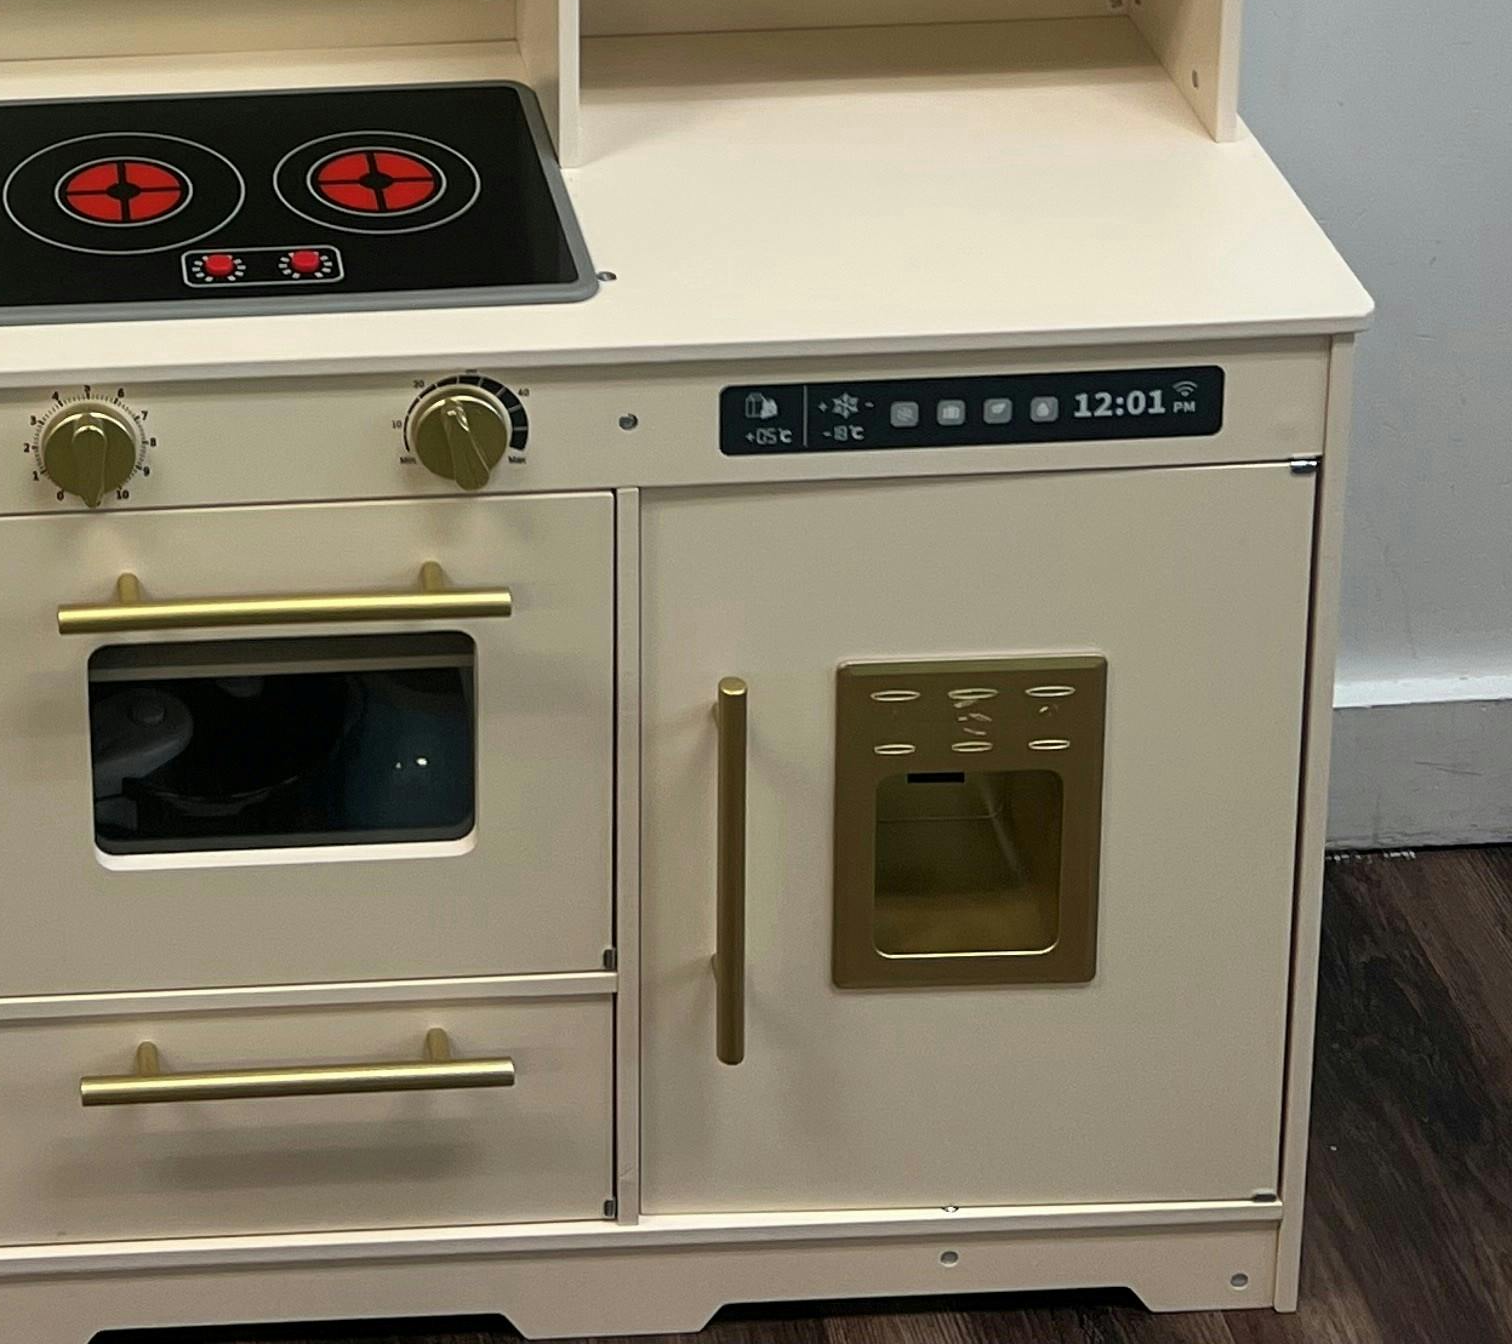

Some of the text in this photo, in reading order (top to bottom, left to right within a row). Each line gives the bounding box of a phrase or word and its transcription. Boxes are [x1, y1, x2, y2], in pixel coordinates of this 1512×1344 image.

[52, 391, 59, 401] 4
[118, 388, 125, 398] 6
[1074, 390, 1195, 417] 12:01 PM
[141, 410, 148, 420] 7
[150, 438, 156, 447] 8
[23, 443, 30, 453] 2
[33, 471, 40, 481] 1
[143, 467, 150, 477] 9
[56, 491, 64, 501] 0
[116, 490, 130, 501] 10
